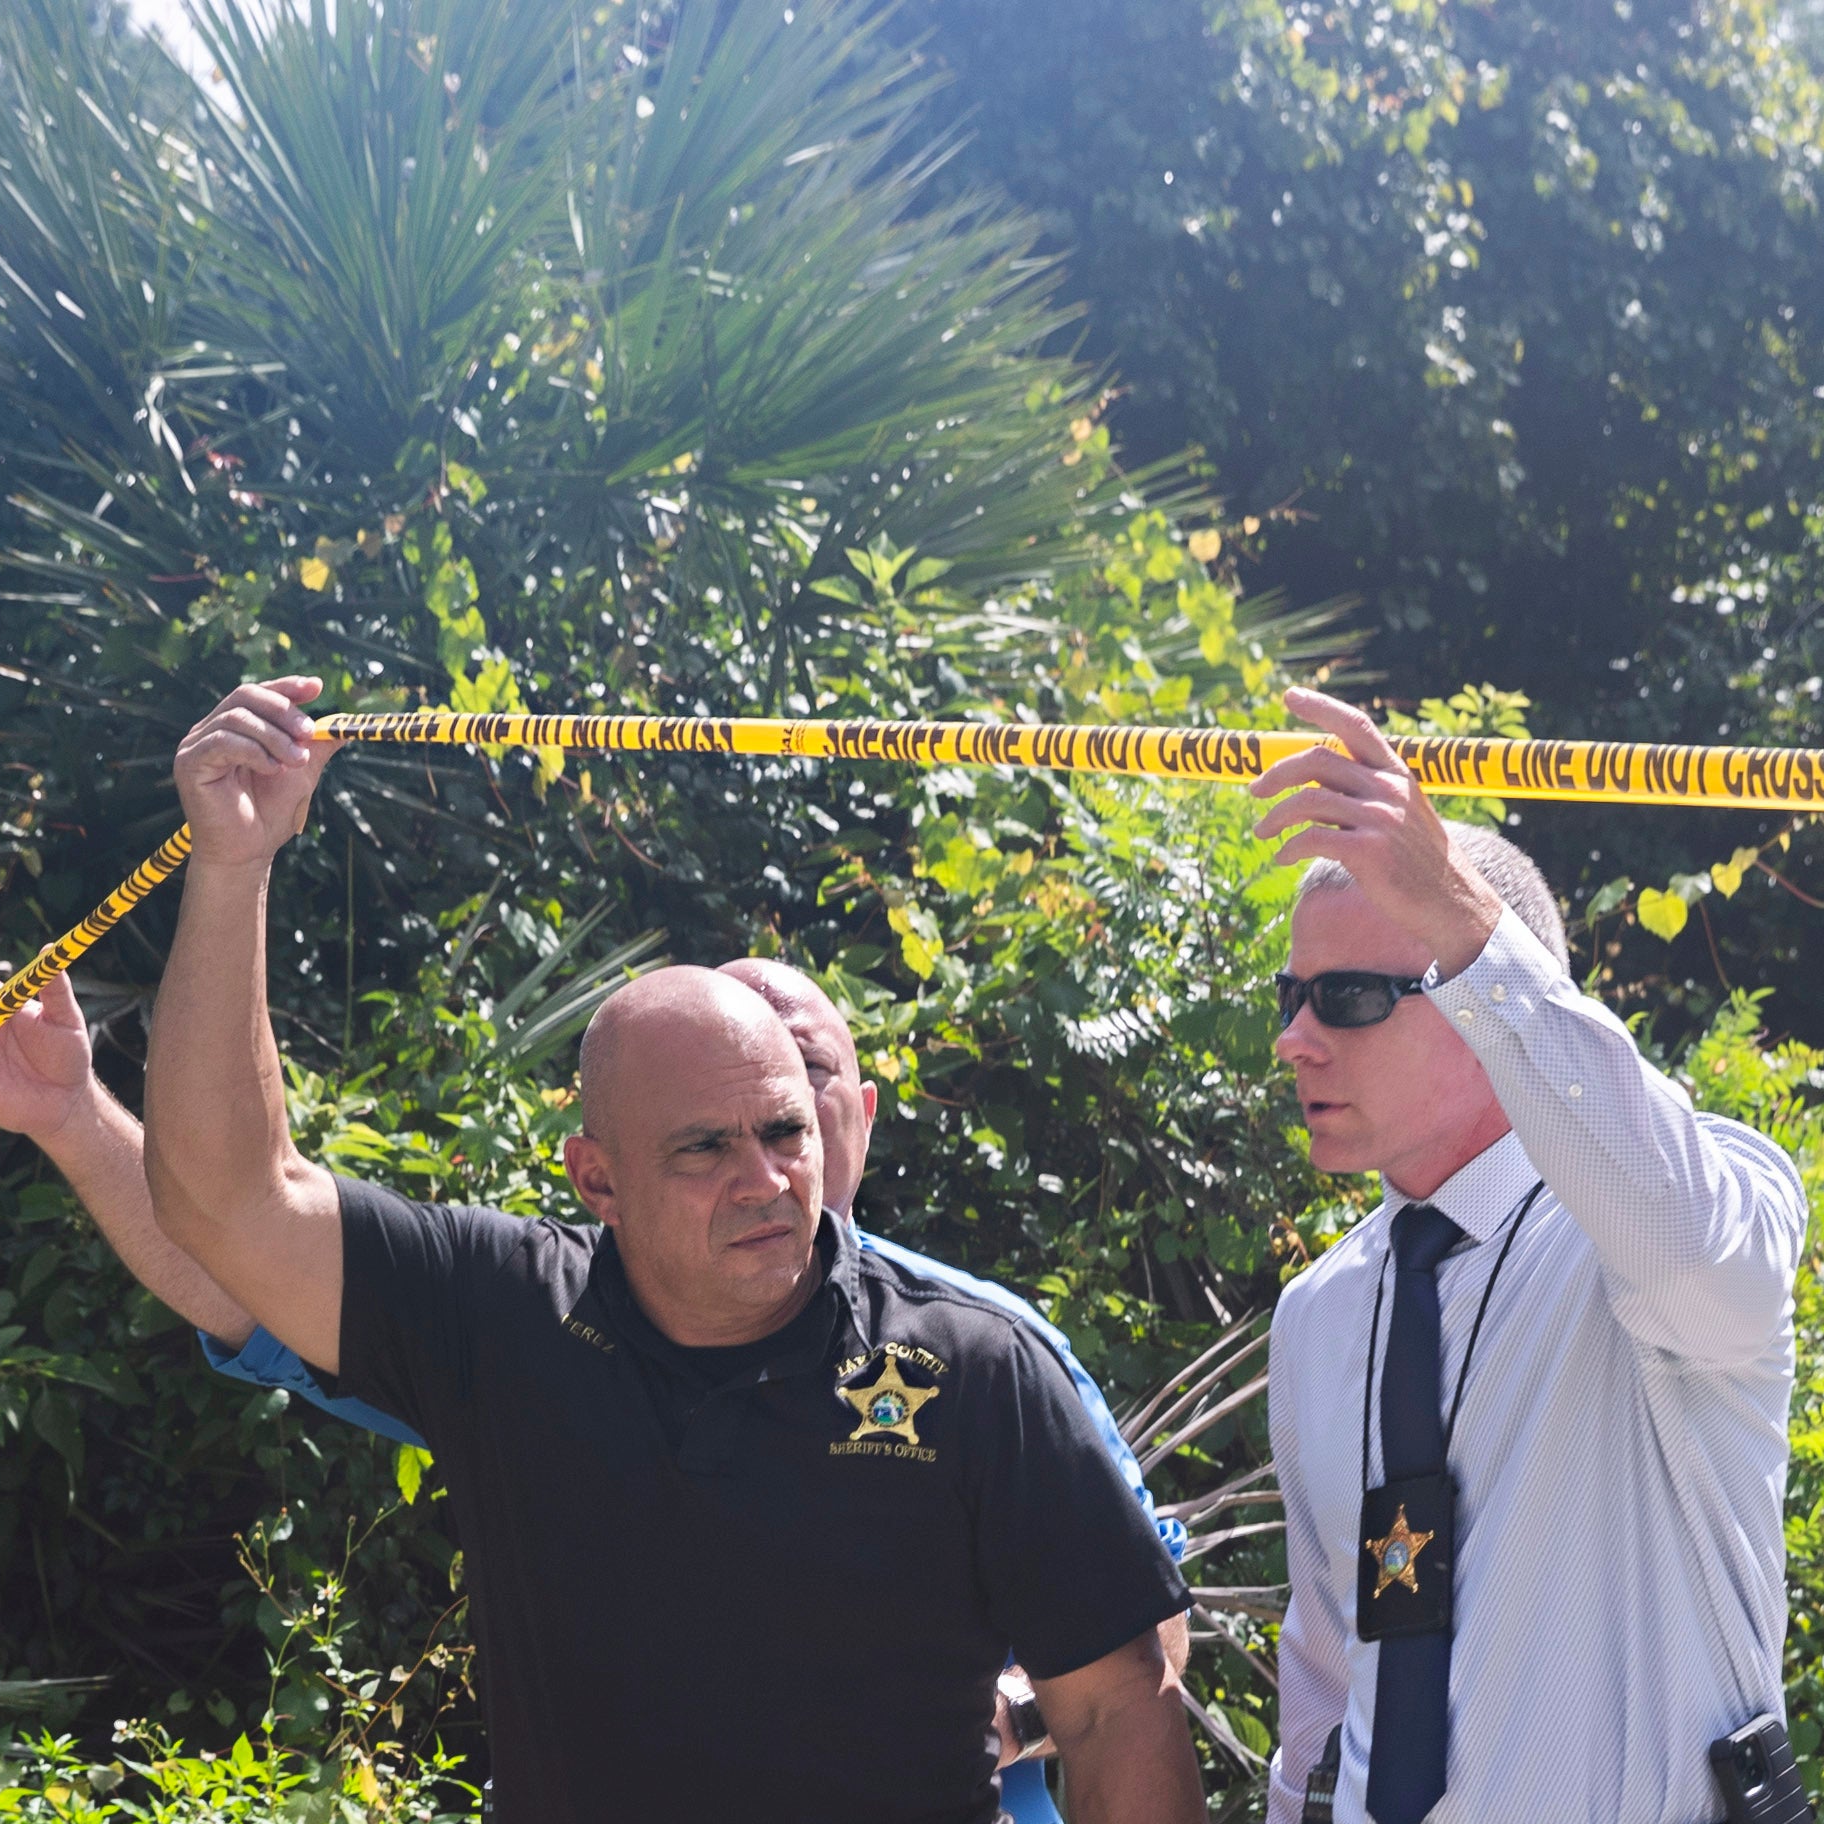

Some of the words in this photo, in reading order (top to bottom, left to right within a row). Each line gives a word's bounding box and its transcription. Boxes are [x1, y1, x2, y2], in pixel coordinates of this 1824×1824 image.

[823, 721, 945, 761] SHERIFF
[955, 723, 1024, 765] LINE
[1159, 728, 1263, 776] CROSS
[1388, 736, 1491, 785] ERIFF
[1503, 739, 1576, 790] LINE
[1585, 743, 1633, 793] DO
